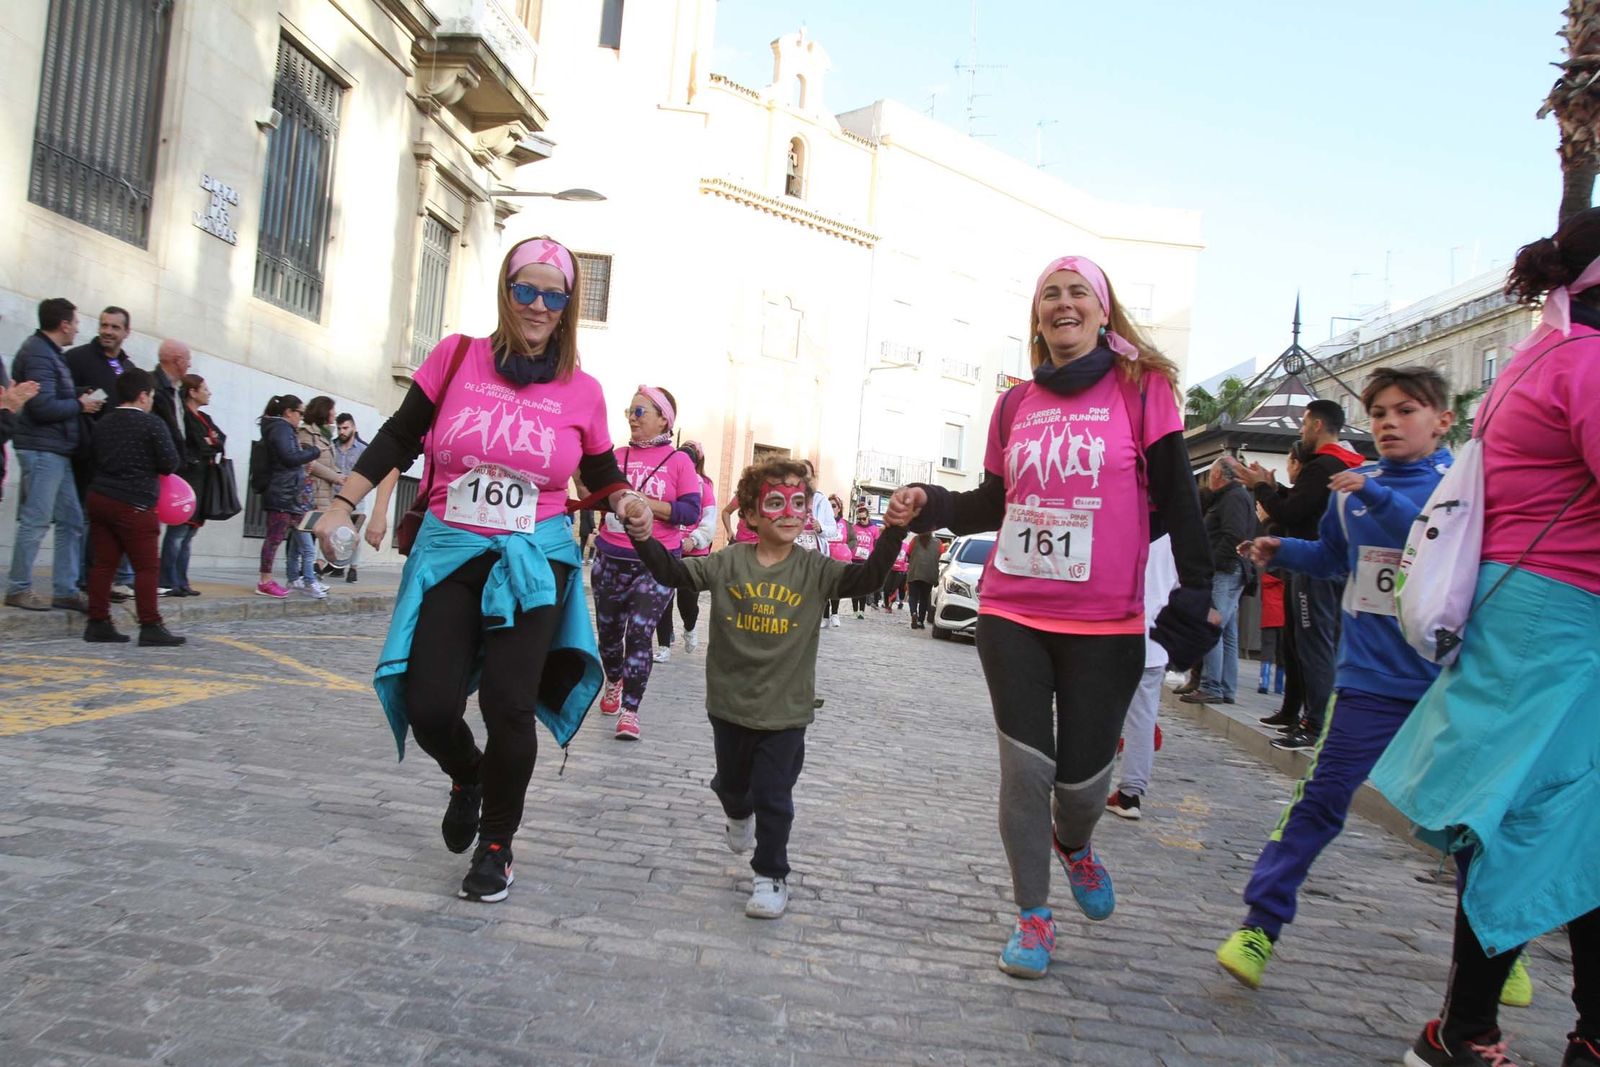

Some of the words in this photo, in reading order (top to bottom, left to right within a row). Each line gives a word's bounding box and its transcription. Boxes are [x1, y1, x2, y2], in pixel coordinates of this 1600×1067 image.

[480, 382, 516, 396] CARRERA
[464, 382, 474, 391] DE
[475, 385, 485, 395] LA
[486, 390, 515, 402] MUJER
[522, 399, 562, 415] RUNNING
[542, 398, 562, 409] PINK
[1026, 408, 1062, 421] CARRERA
[1088, 407, 1110, 415] PINK
[1022, 420, 1032, 429] LA
[1032, 414, 1061, 426] MUJER
[1069, 413, 1110, 422] RUNNING
[467, 477, 524, 509] 160
[1069, 513, 1089, 521] PINK
[1017, 527, 1072, 558] 161
[728, 581, 802, 608] NACIDO
[752, 603, 775, 616] PARA
[735, 611, 790, 635] LUCHAR
